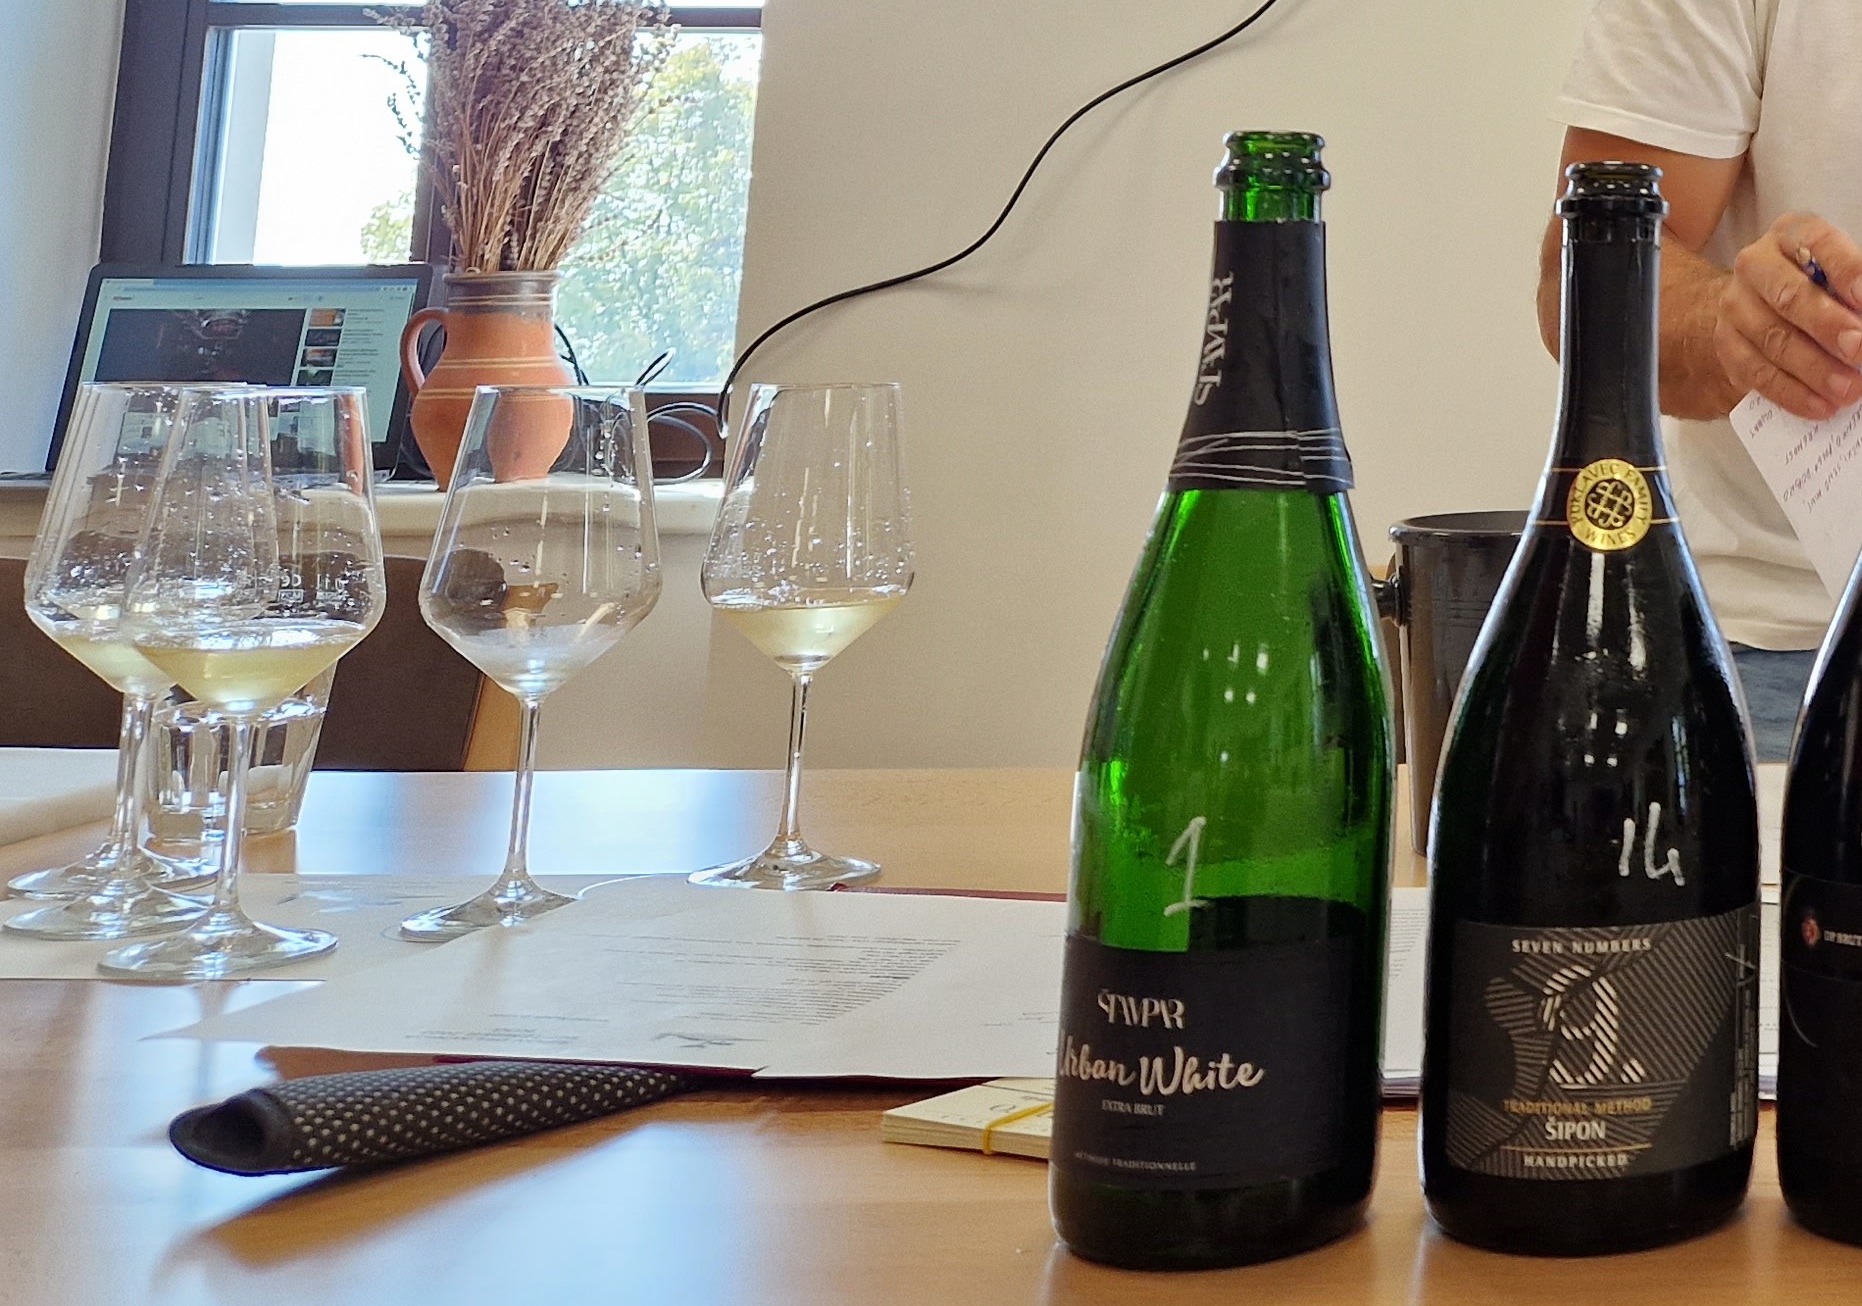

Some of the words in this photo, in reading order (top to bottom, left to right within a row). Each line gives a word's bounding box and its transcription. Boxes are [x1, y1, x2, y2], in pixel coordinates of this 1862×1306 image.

[1624, 467, 1648, 524] FAMILY
[1585, 527, 1636, 545] WINES
[1618, 801, 1686, 887] 14
[1164, 816, 1214, 917] 1
[1511, 939, 1563, 954] SEVEN
[1571, 937, 1652, 954] NUMBERS
[1139, 1046, 1265, 1097] White
[1101, 1099, 1133, 1115] EXTRA
[1133, 1102, 1165, 1116] BRUT
[1503, 1098, 1589, 1115] TRADITIONAL
[1594, 1096, 1653, 1114] METHOD
[1545, 1116, 1606, 1141] ŠIPON
[1523, 1153, 1631, 1169] HANDPICKED
